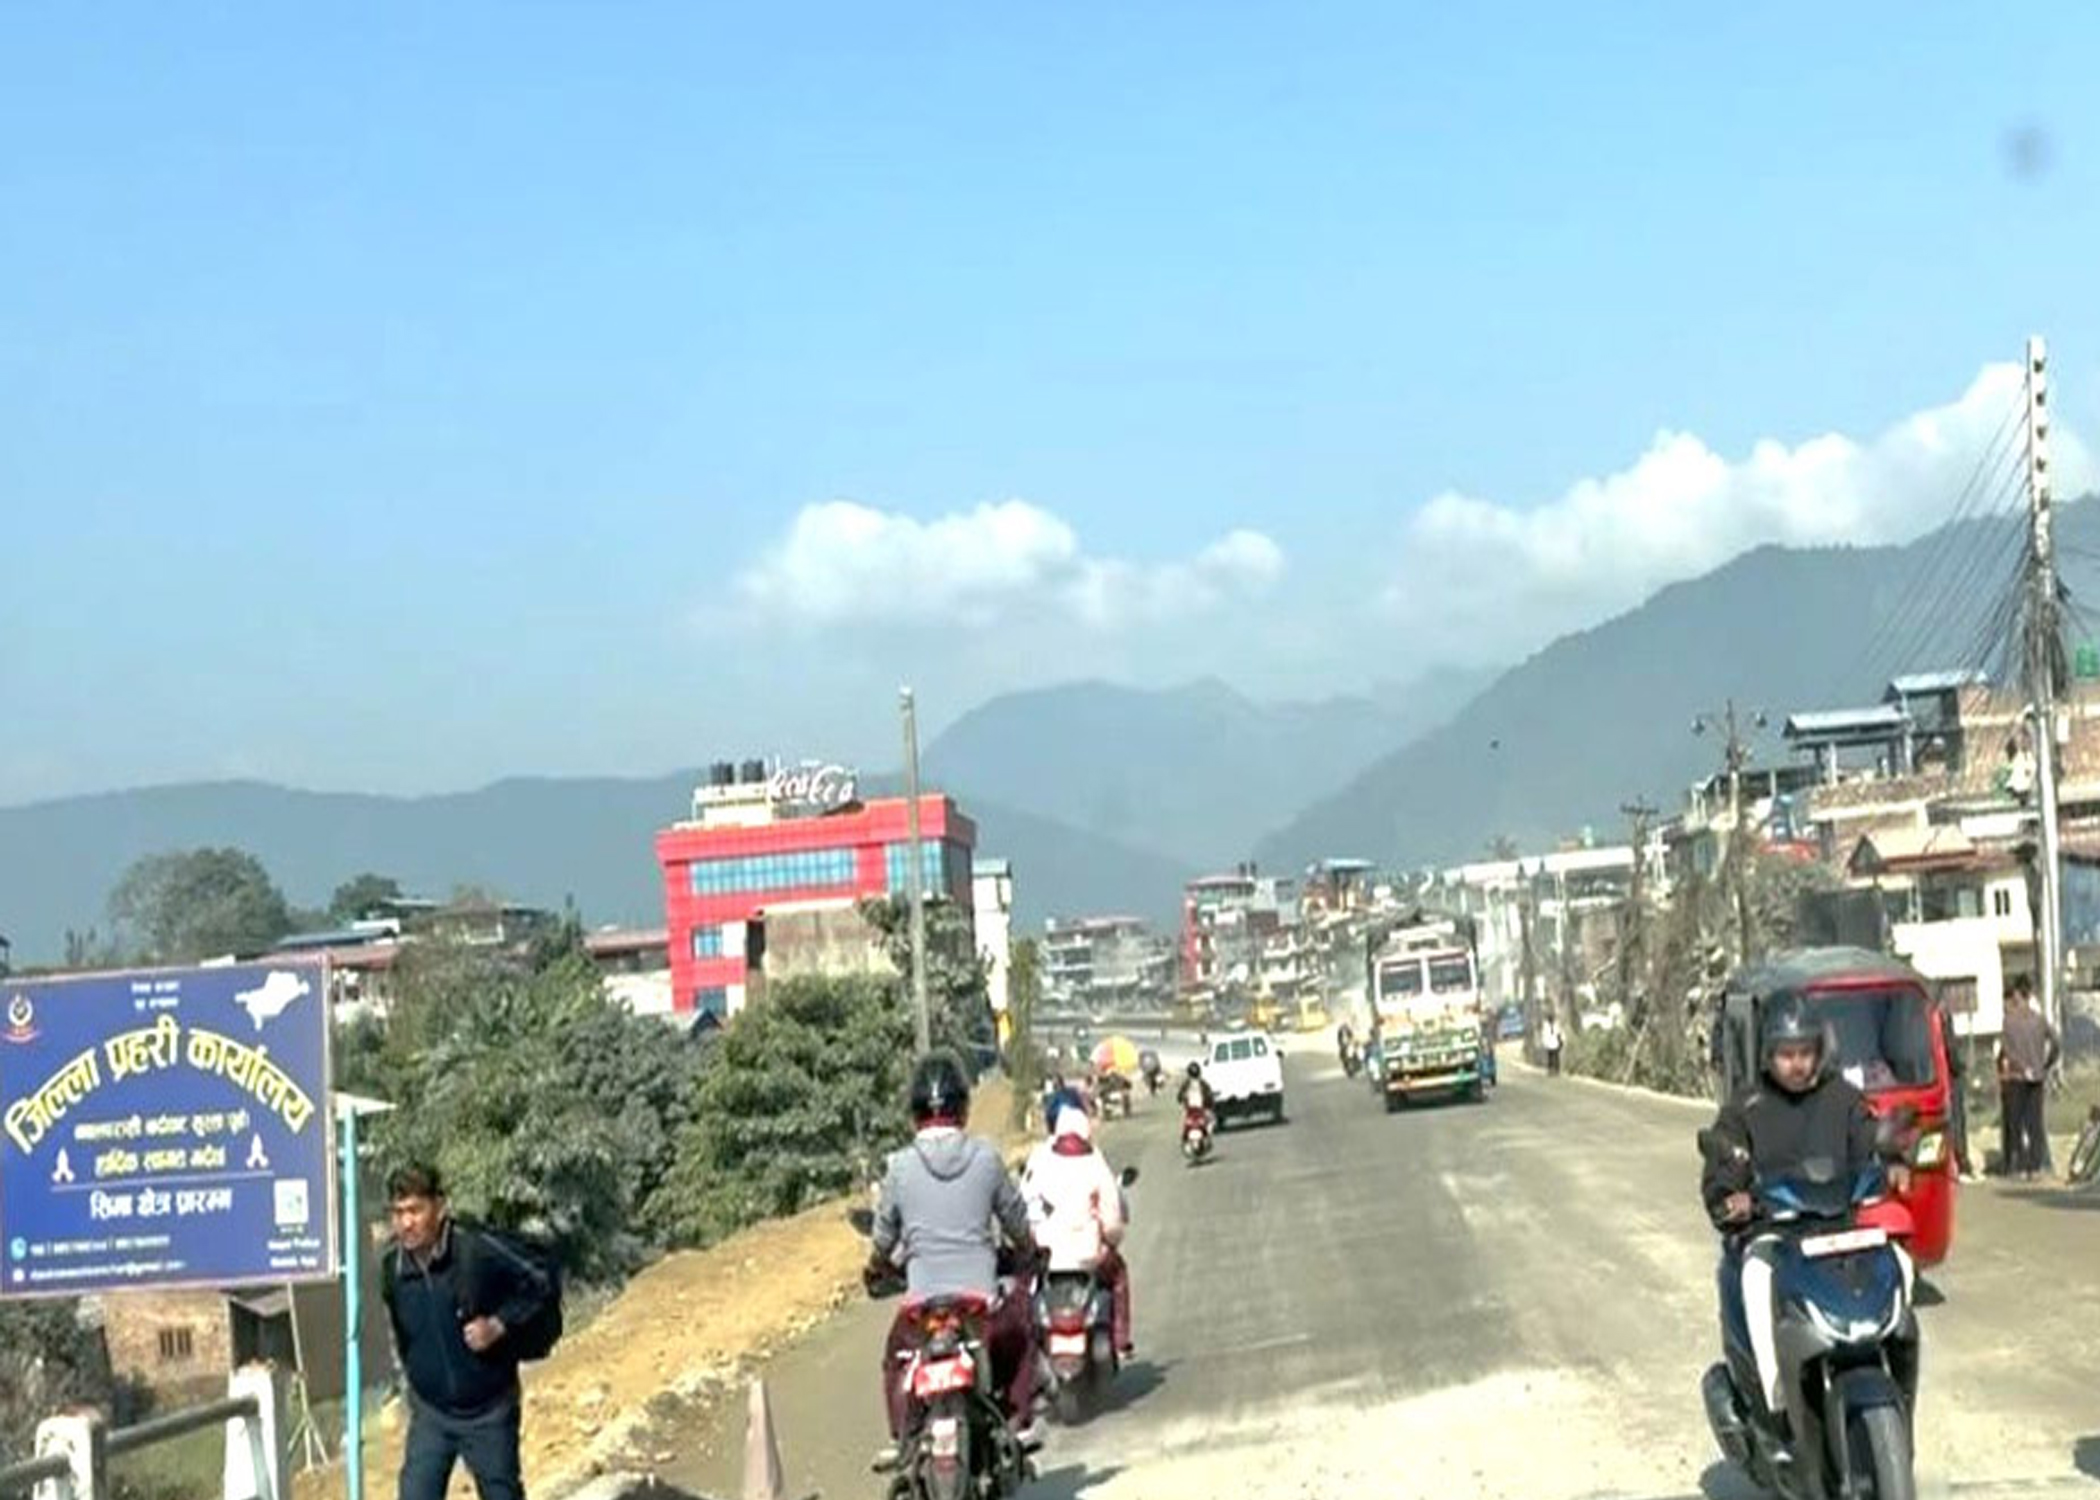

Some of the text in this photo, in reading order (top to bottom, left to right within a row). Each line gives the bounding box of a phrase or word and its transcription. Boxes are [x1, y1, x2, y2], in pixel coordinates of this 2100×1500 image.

[4, 1014, 315, 1154] जिल्ला प्रहरी कार्यालय
